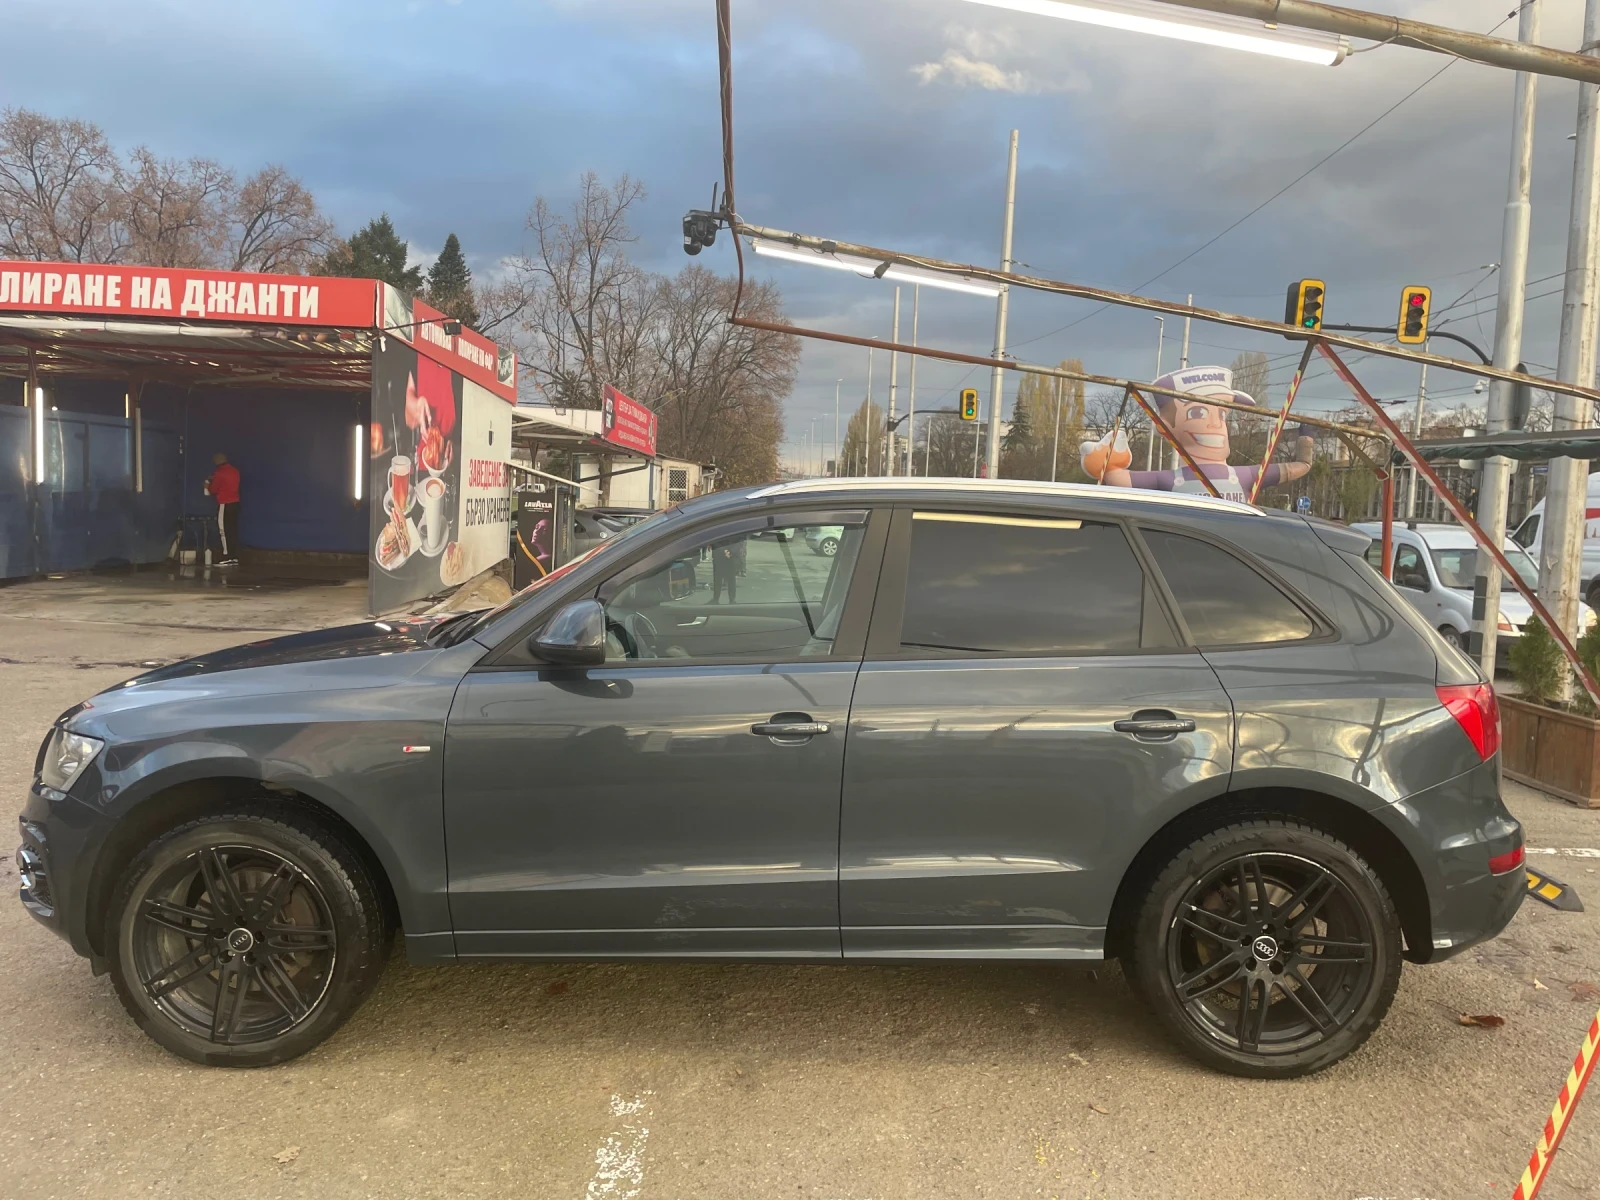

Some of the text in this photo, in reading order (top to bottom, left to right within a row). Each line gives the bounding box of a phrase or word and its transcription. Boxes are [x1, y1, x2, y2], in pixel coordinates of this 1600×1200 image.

[0, 271, 319, 318] ЛИРАНЕ НА ДЖАНТИ
[1181, 373, 1226, 385] WELCOME
[468, 458, 502, 491] ЗАВЕДЕНИЕ
[465, 497, 486, 527] БЪРЗО
